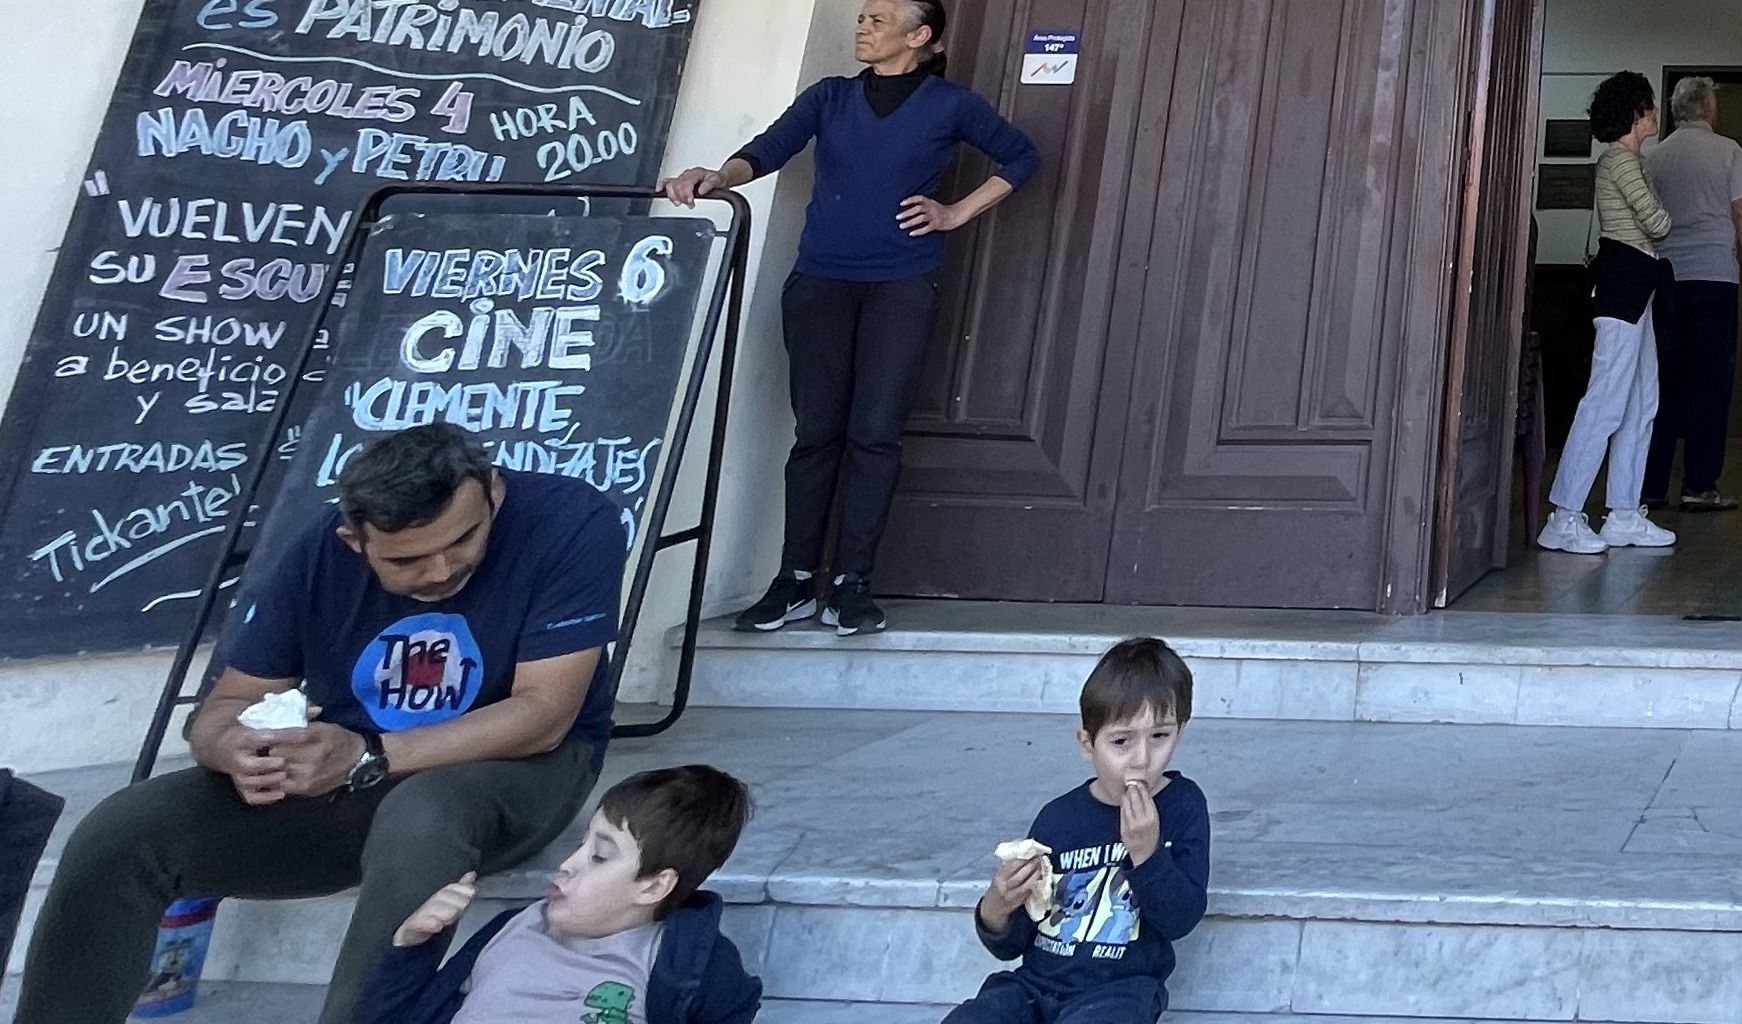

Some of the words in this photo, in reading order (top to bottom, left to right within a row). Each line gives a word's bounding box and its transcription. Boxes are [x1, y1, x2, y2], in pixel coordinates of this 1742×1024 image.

[430, 80, 475, 134] 4
[489, 94, 597, 142] HORA
[136, 106, 312, 169] NACHO
[88, 250, 157, 284] SU
[159, 254, 331, 305] ESCU
[382, 247, 606, 303] VIERNES
[618, 235, 675, 305] 6
[72, 311, 128, 341] UN
[155, 315, 287, 350] SHOW
[103, 346, 287, 393] beneficio
[31, 439, 248, 474] ENTRADAS
[1060, 845, 1102, 870] WHEN
[1103, 844, 1112, 864] I
